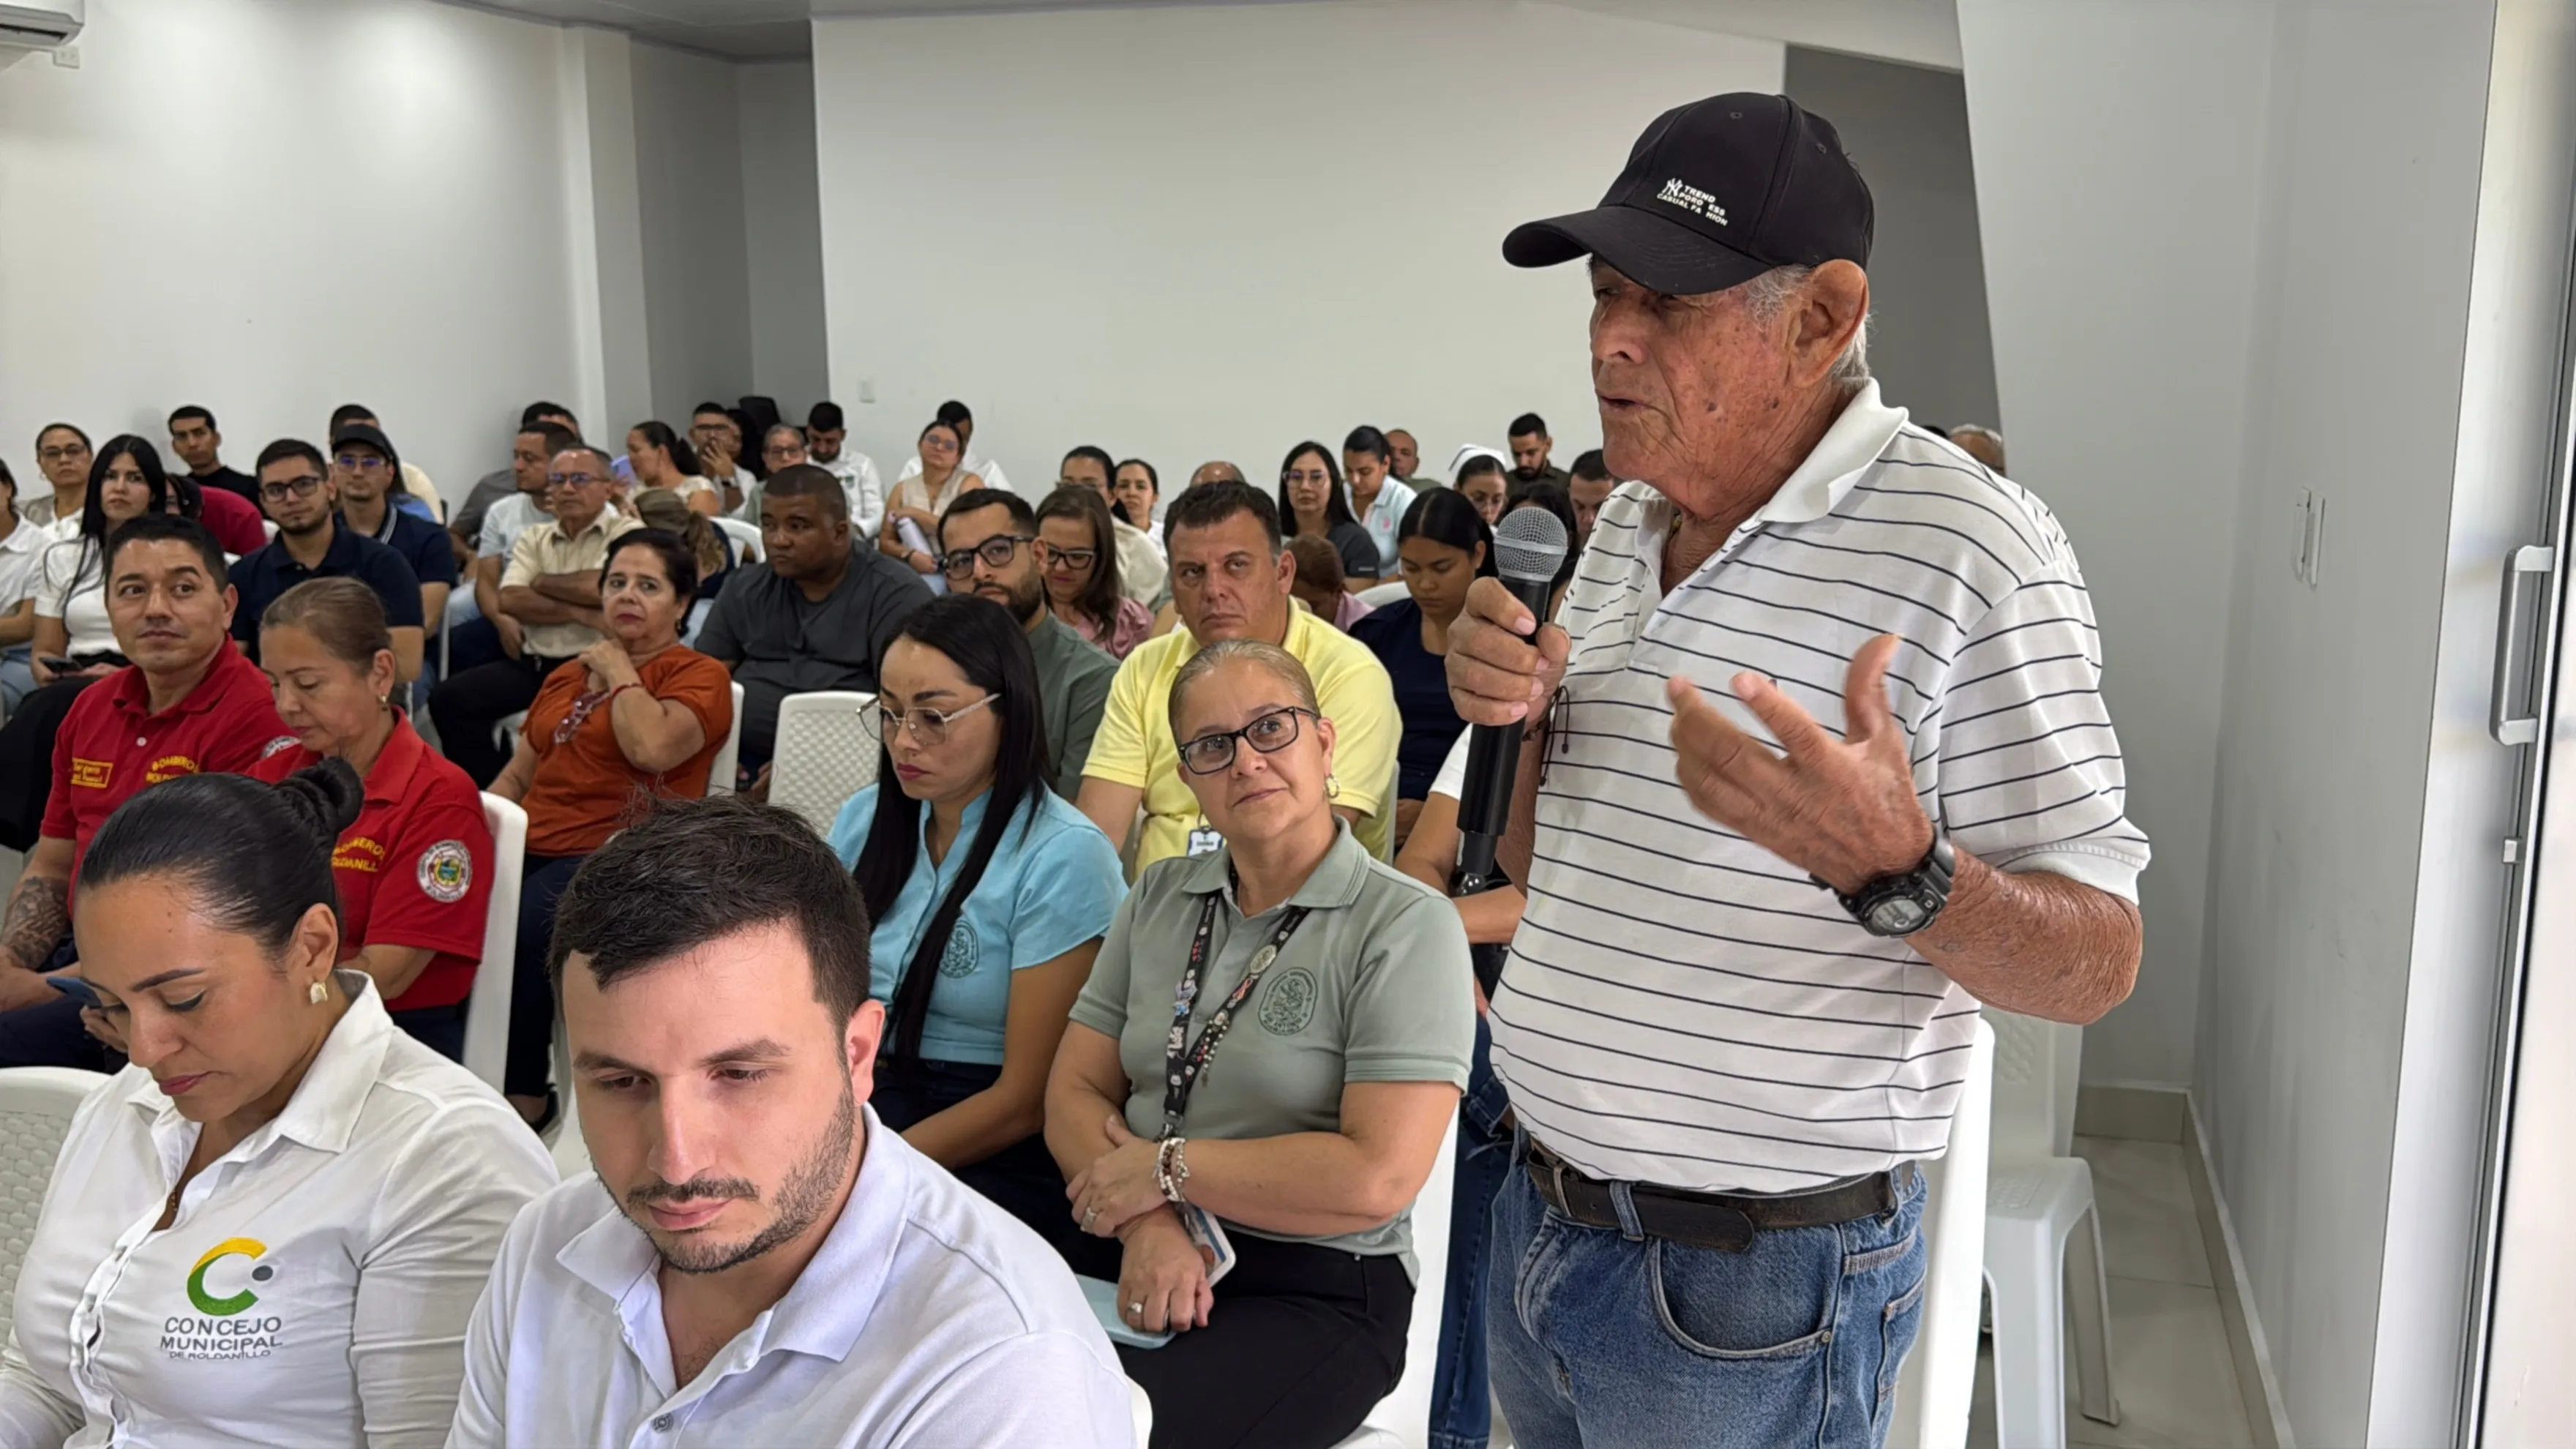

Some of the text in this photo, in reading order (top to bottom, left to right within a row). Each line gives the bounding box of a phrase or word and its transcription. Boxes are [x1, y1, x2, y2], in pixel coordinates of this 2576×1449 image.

[1657, 193, 1688, 209] CASUAL
[1685, 185, 1715, 203] TREND
[1708, 204, 1725, 216] ESS
[165, 1317, 282, 1336] CONCEJO
[160, 1336, 283, 1351] MUNICIPAL
[170, 1349, 271, 1360] DE ROLDANILLO
